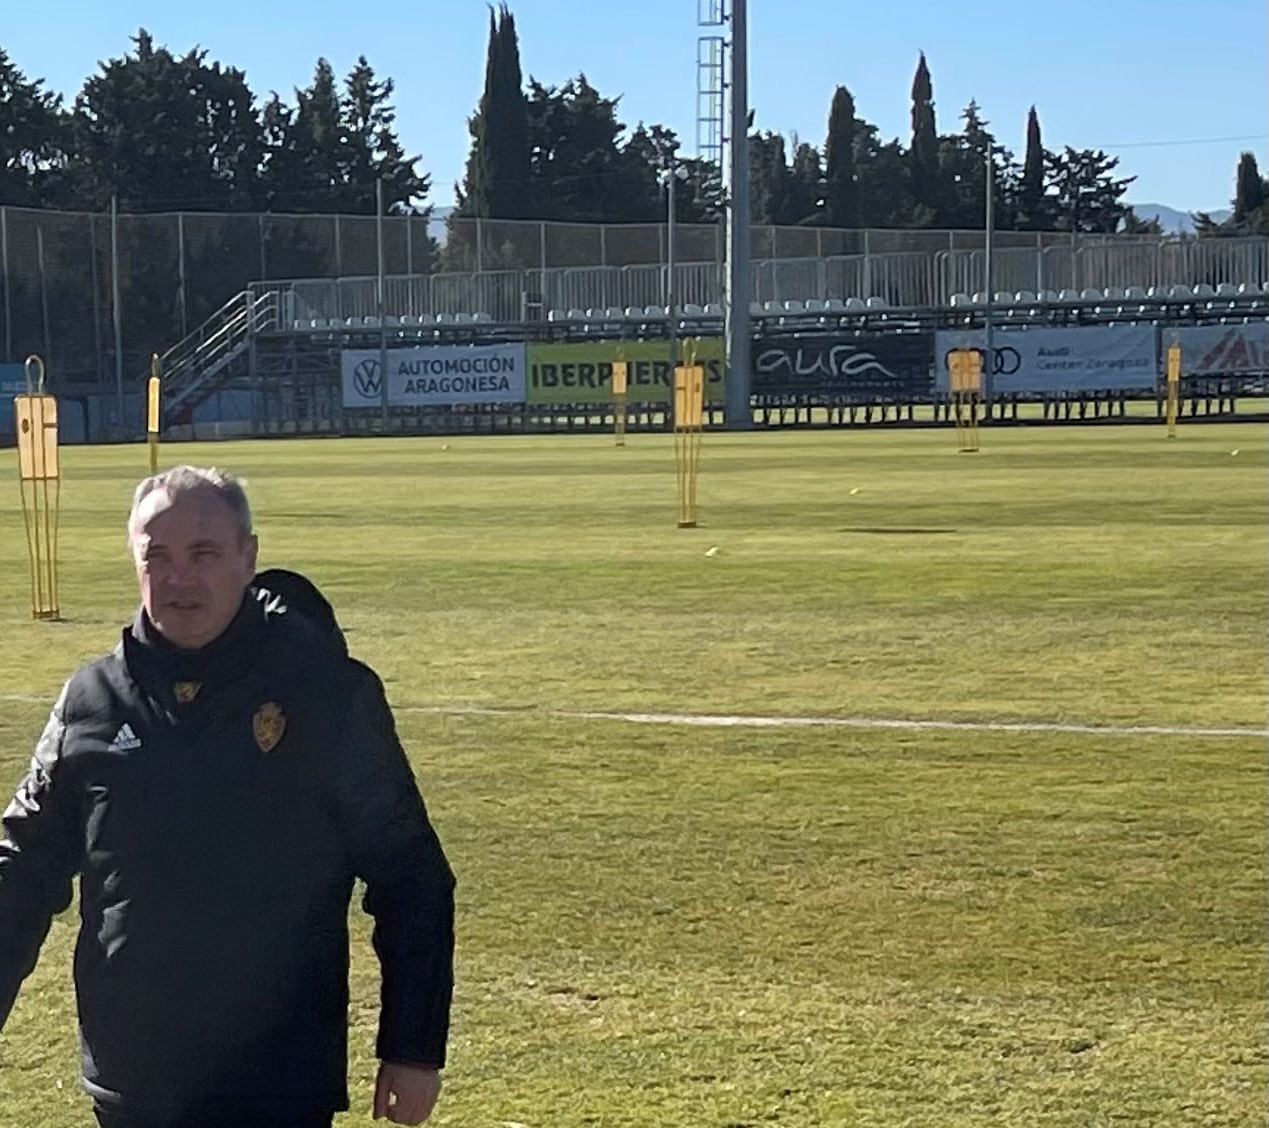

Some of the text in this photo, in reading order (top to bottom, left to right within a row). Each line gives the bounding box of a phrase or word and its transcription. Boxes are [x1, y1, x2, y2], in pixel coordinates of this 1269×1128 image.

[398, 356, 515, 376] AUTOMOCIÓN
[756, 345, 897, 377] aura
[404, 376, 511, 394] ARAGONESA
[532, 359, 722, 389] IBERPERS
